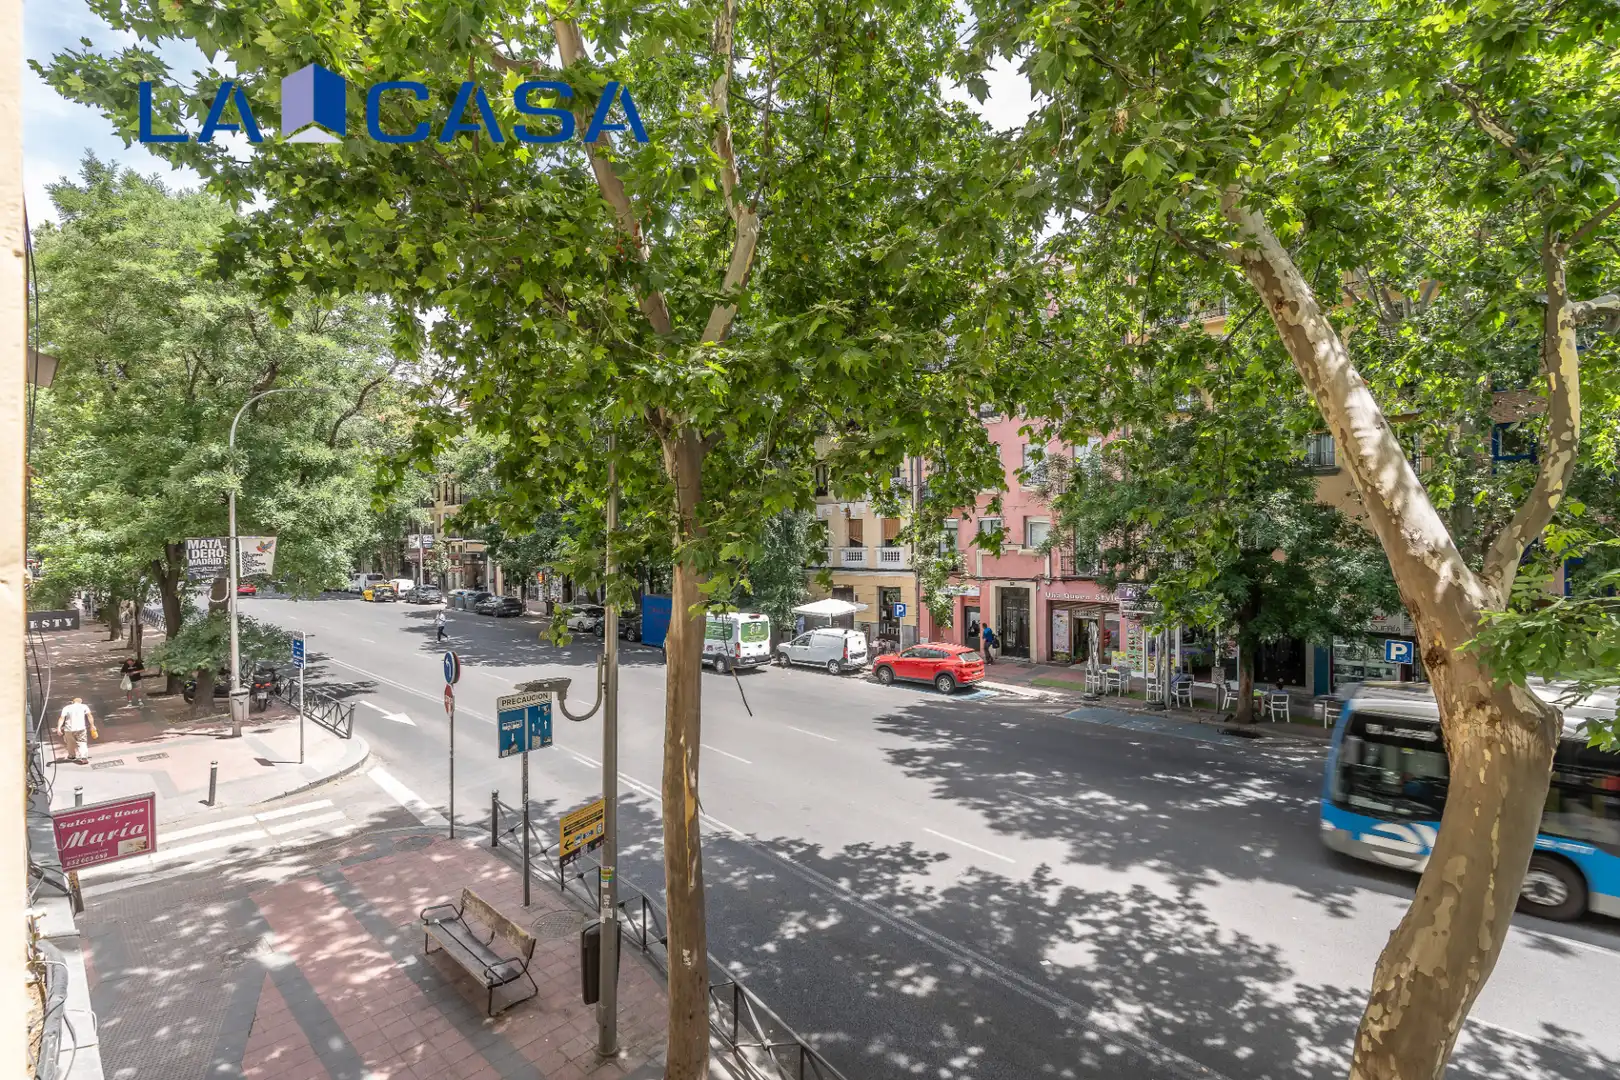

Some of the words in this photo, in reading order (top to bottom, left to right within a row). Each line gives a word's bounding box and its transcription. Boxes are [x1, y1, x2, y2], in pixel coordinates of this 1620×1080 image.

[191, 548, 225, 559] DERO
[189, 557, 222, 567] MADRID
[896, 604, 904, 616] P
[1390, 642, 1408, 660] P
[501, 692, 548, 707] PRECAUCION
[59, 817, 95, 830] Salón
[97, 813, 112, 822] de
[62, 821, 146, 850] María
